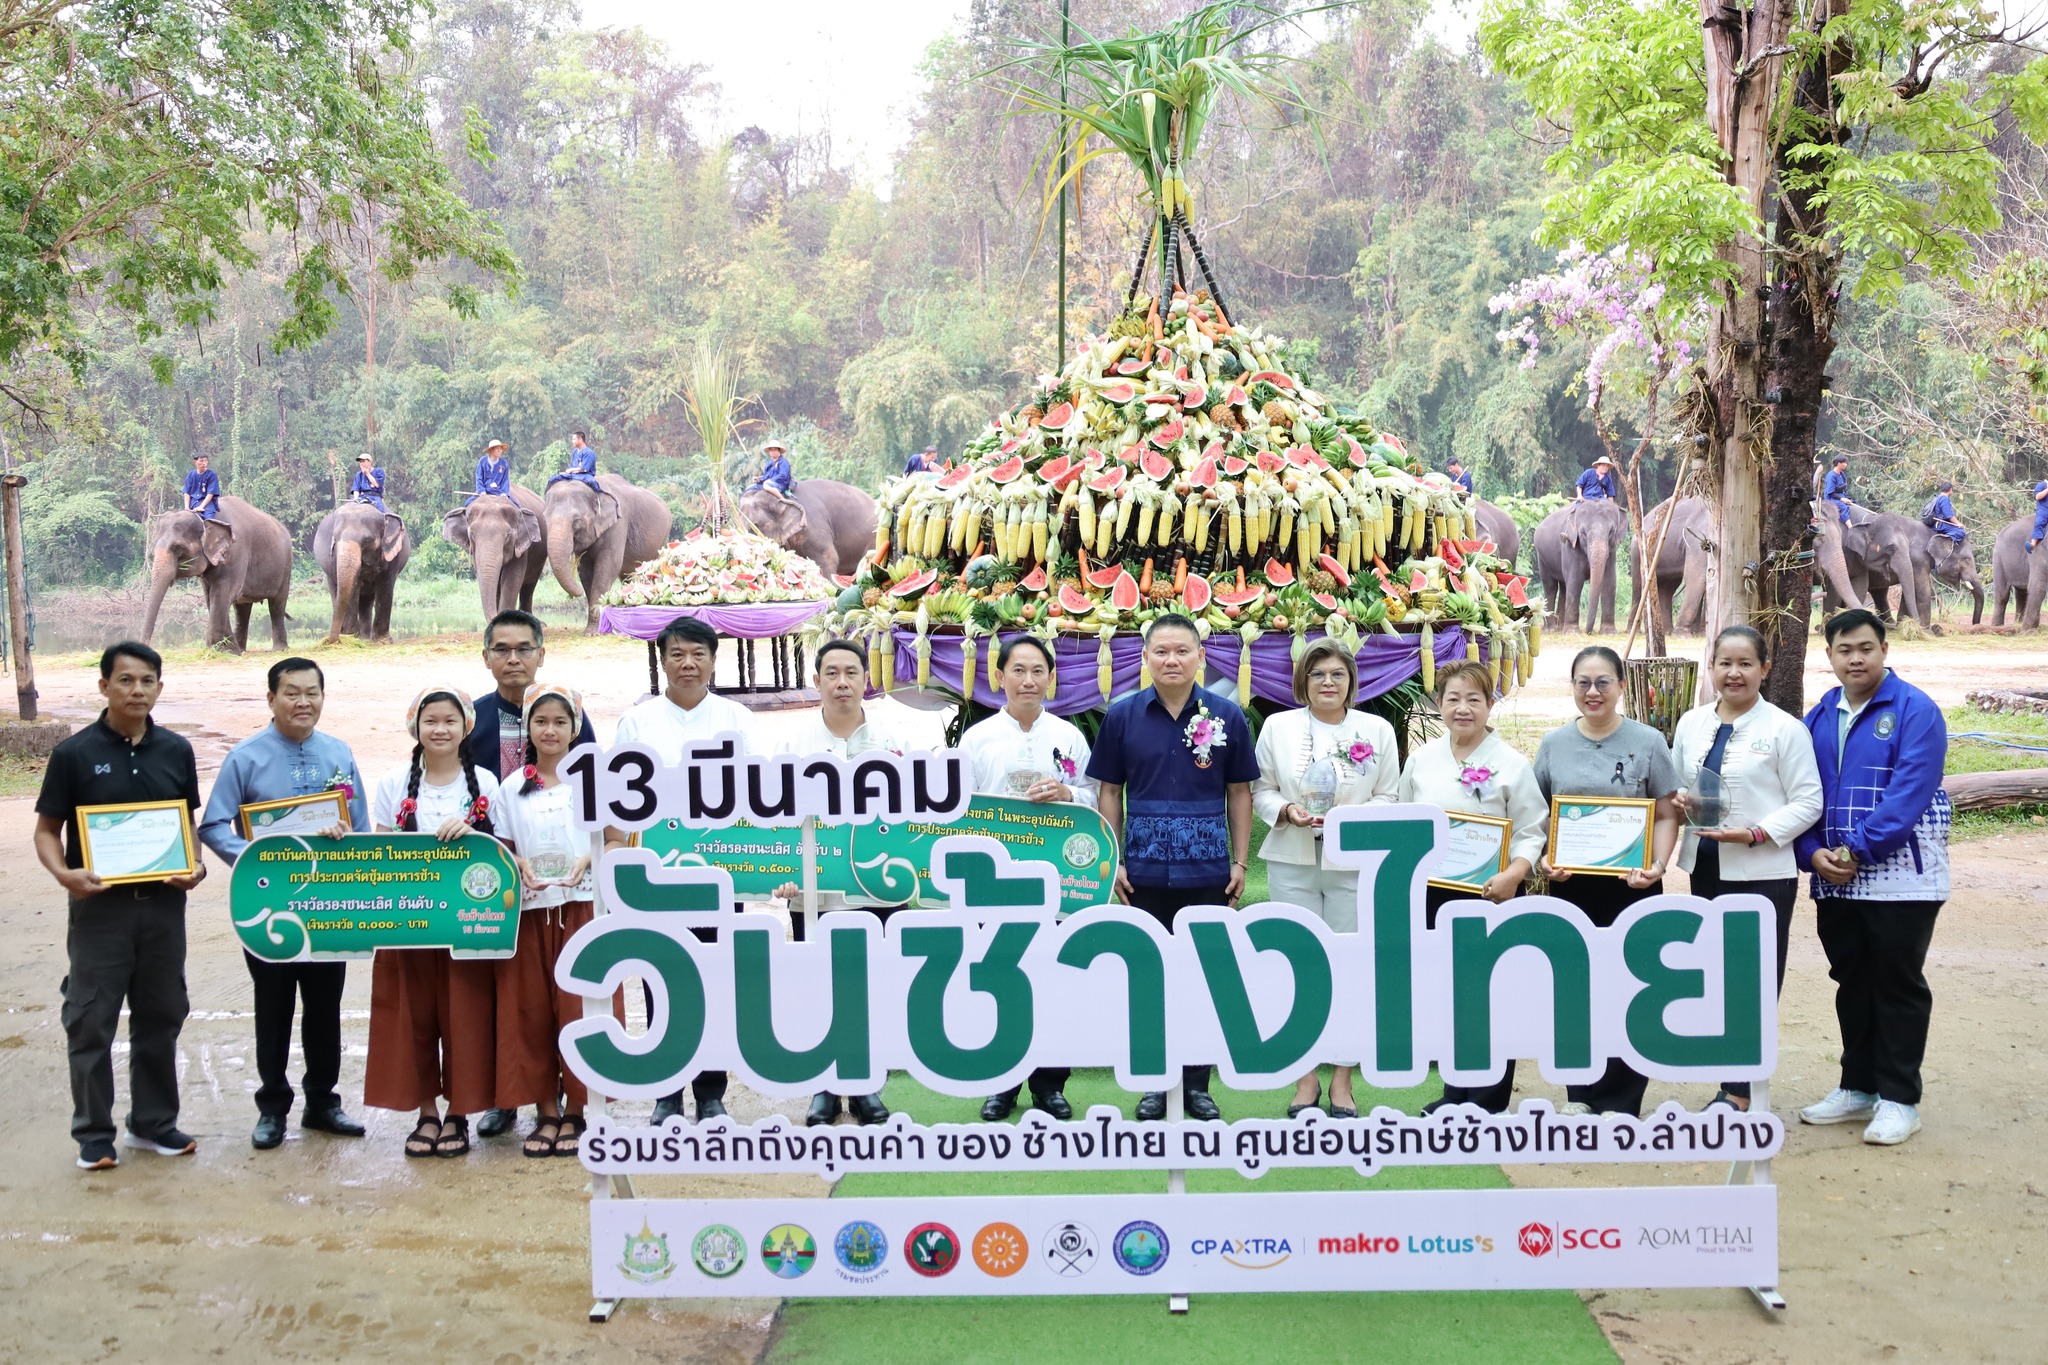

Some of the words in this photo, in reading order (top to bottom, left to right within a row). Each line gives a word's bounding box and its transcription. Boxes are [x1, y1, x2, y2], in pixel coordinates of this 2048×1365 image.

[566, 750, 659, 823] 13
[687, 740, 963, 821] มีนาคม
[998, 807, 1075, 829] ในพระอุปถัมภ์ฯ
[386, 845, 471, 864] ในพระอุปถัมภ์ฯ
[693, 840, 791, 855] รางวัลรองชนะเลิศ
[833, 847, 843, 857] ๒
[287, 897, 393, 912] รางวัลรองชนะเลิศ
[398, 895, 434, 911] อันดับ
[438, 901, 449, 910] ๑
[306, 917, 354, 931] เงินรางวัล
[407, 918, 429, 929] บาท
[456, 908, 506, 922] วันช้างไทย
[570, 820, 1762, 1085] วันช้างไทย
[587, 1125, 925, 1171] ร่วมรำลึกถึงคุณค่า
[937, 1133, 1011, 1160] ของ
[1023, 1117, 1167, 1159] ช้างไทย
[1183, 1131, 1220, 1158] ณ
[1235, 1109, 1599, 1169] ศูนย์อนุรักษ์ช้างไทย
[1613, 1114, 1775, 1152] จ.ลำปาง
[1318, 1232, 1400, 1255] makro
[1408, 1235, 1495, 1254] Lotus's
[1562, 1228, 1622, 1250] SCG
[1637, 1226, 1692, 1250] AOM
[1696, 1226, 1753, 1245] THAI
[1696, 1246, 1717, 1254] Proud
